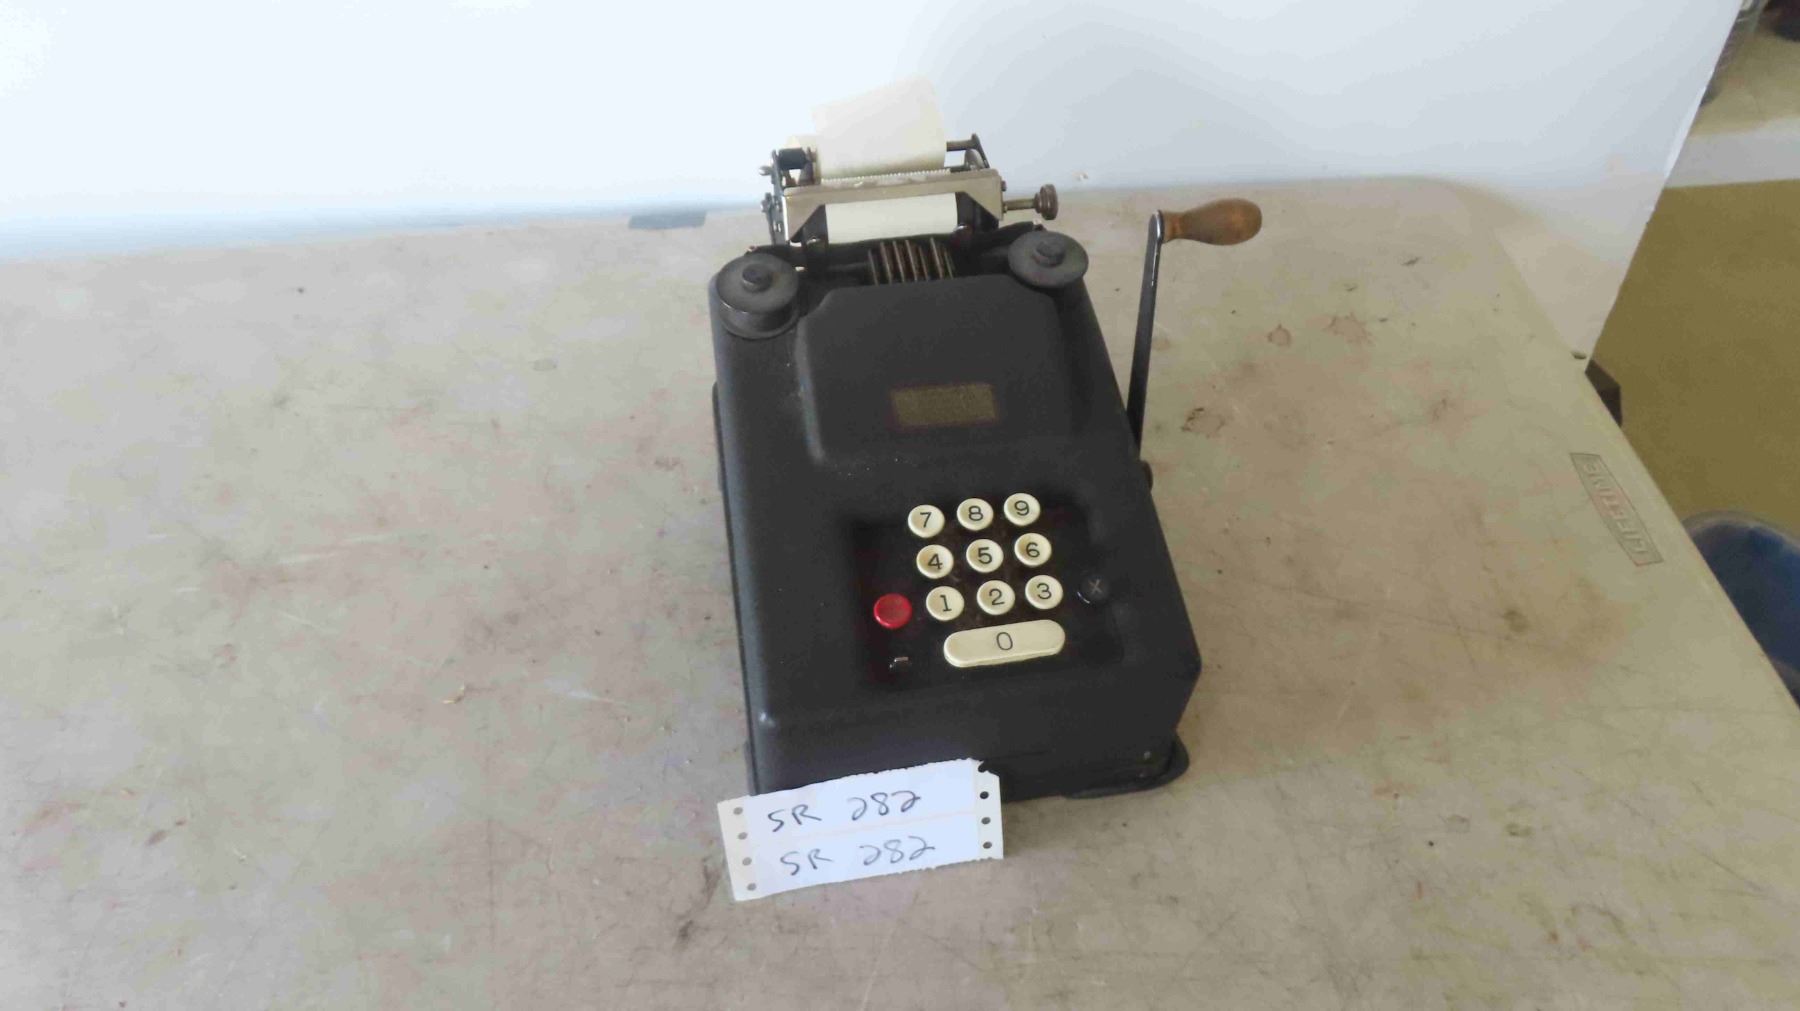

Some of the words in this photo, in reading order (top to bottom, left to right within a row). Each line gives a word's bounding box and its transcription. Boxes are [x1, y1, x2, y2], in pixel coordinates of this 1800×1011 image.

[920, 511, 932, 528] 7
[968, 505, 983, 521] 8
[1014, 500, 1030, 516] 9
[927, 553, 943, 570] 4
[977, 547, 993, 564] 5
[1025, 542, 1040, 558] 6
[939, 594, 952, 612] 1
[988, 588, 1005, 605] 2
[1036, 583, 1052, 600] 3
[996, 631, 1013, 651] 0
[768, 804, 822, 832] SR
[848, 790, 921, 821] 282
[780, 848, 833, 876] SR
[859, 836, 935, 866] 282
